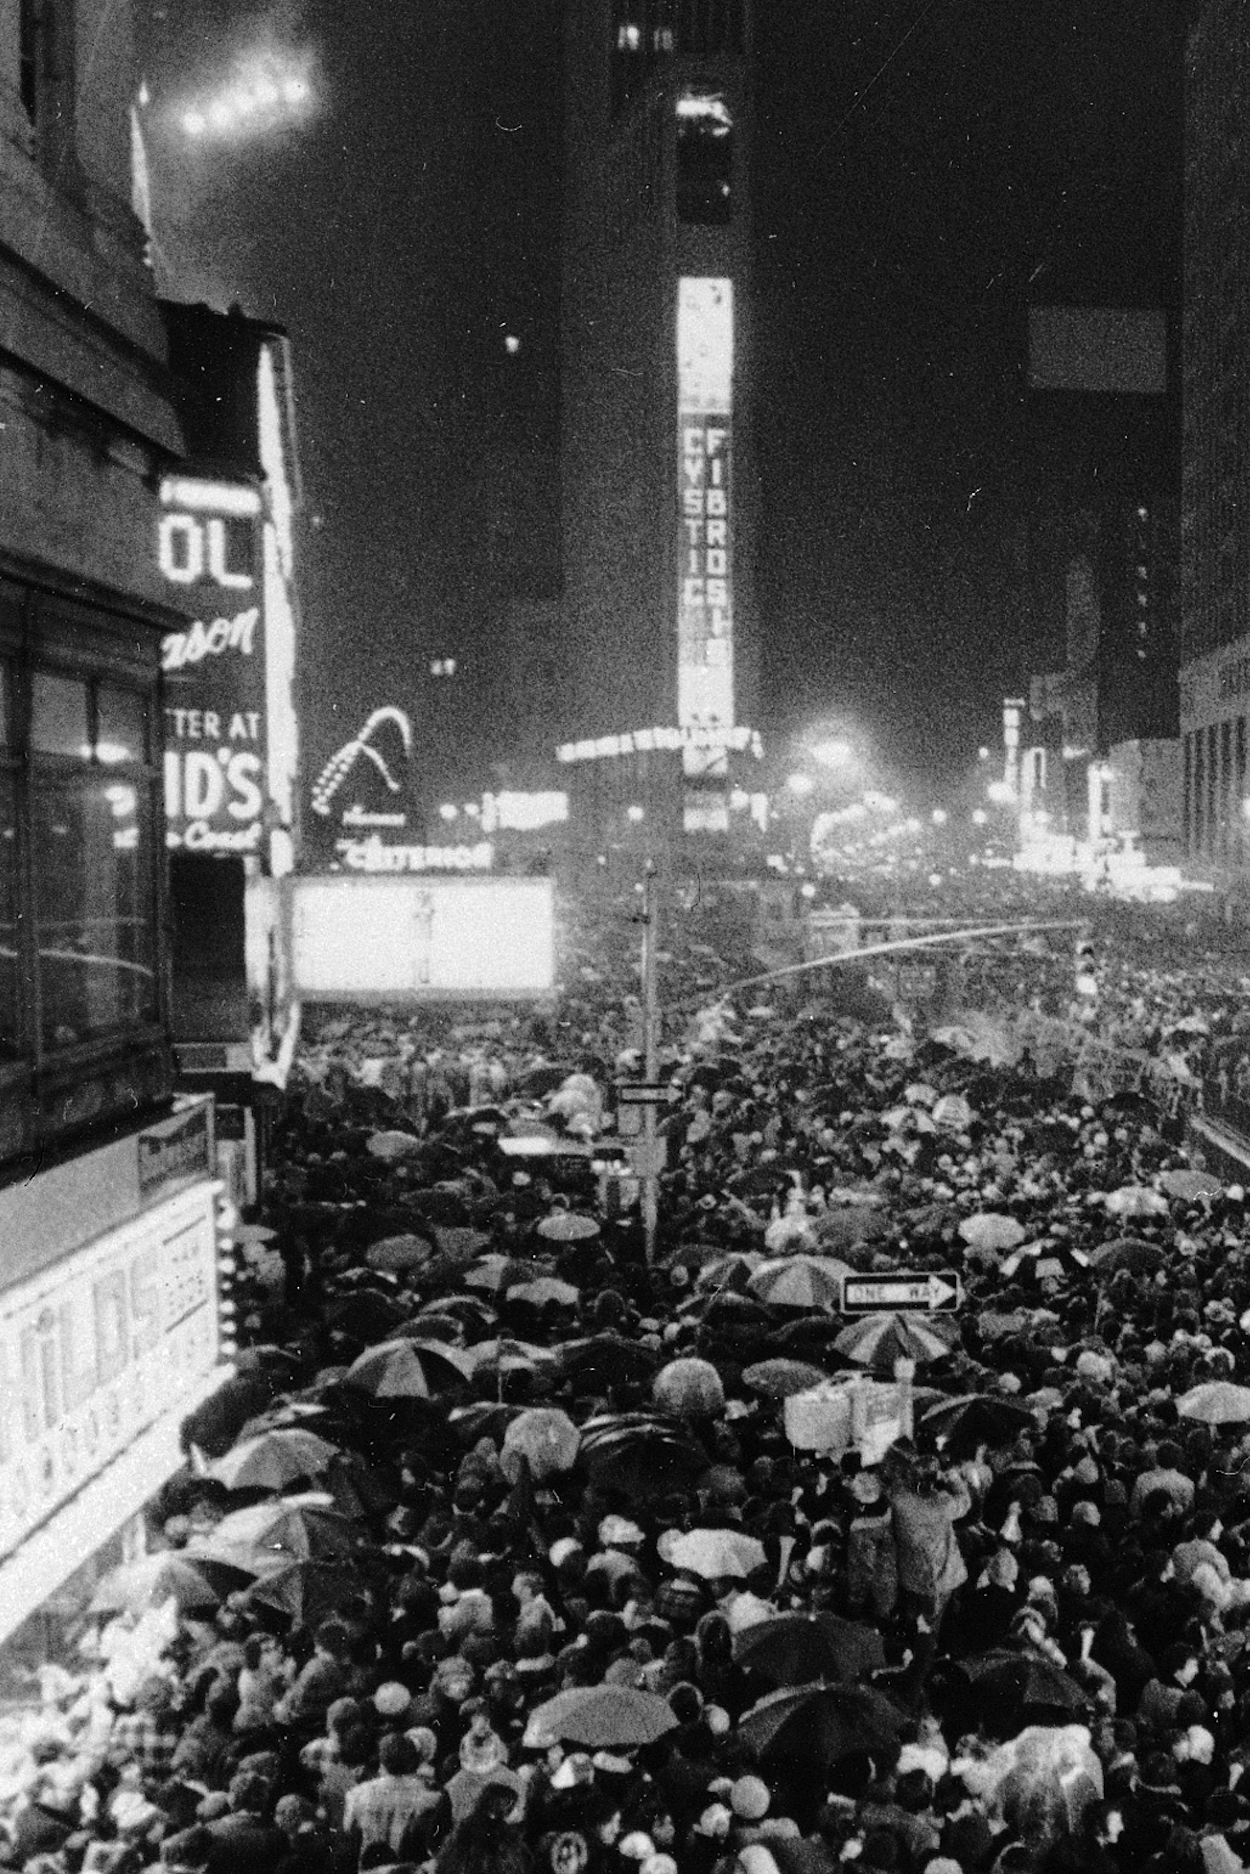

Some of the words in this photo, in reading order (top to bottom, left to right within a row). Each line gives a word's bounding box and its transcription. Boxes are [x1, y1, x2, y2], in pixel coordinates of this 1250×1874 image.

[229, 712, 261, 740] AT
[853, 1285, 886, 1302] ONE
[908, 1283, 941, 1301] WAY
